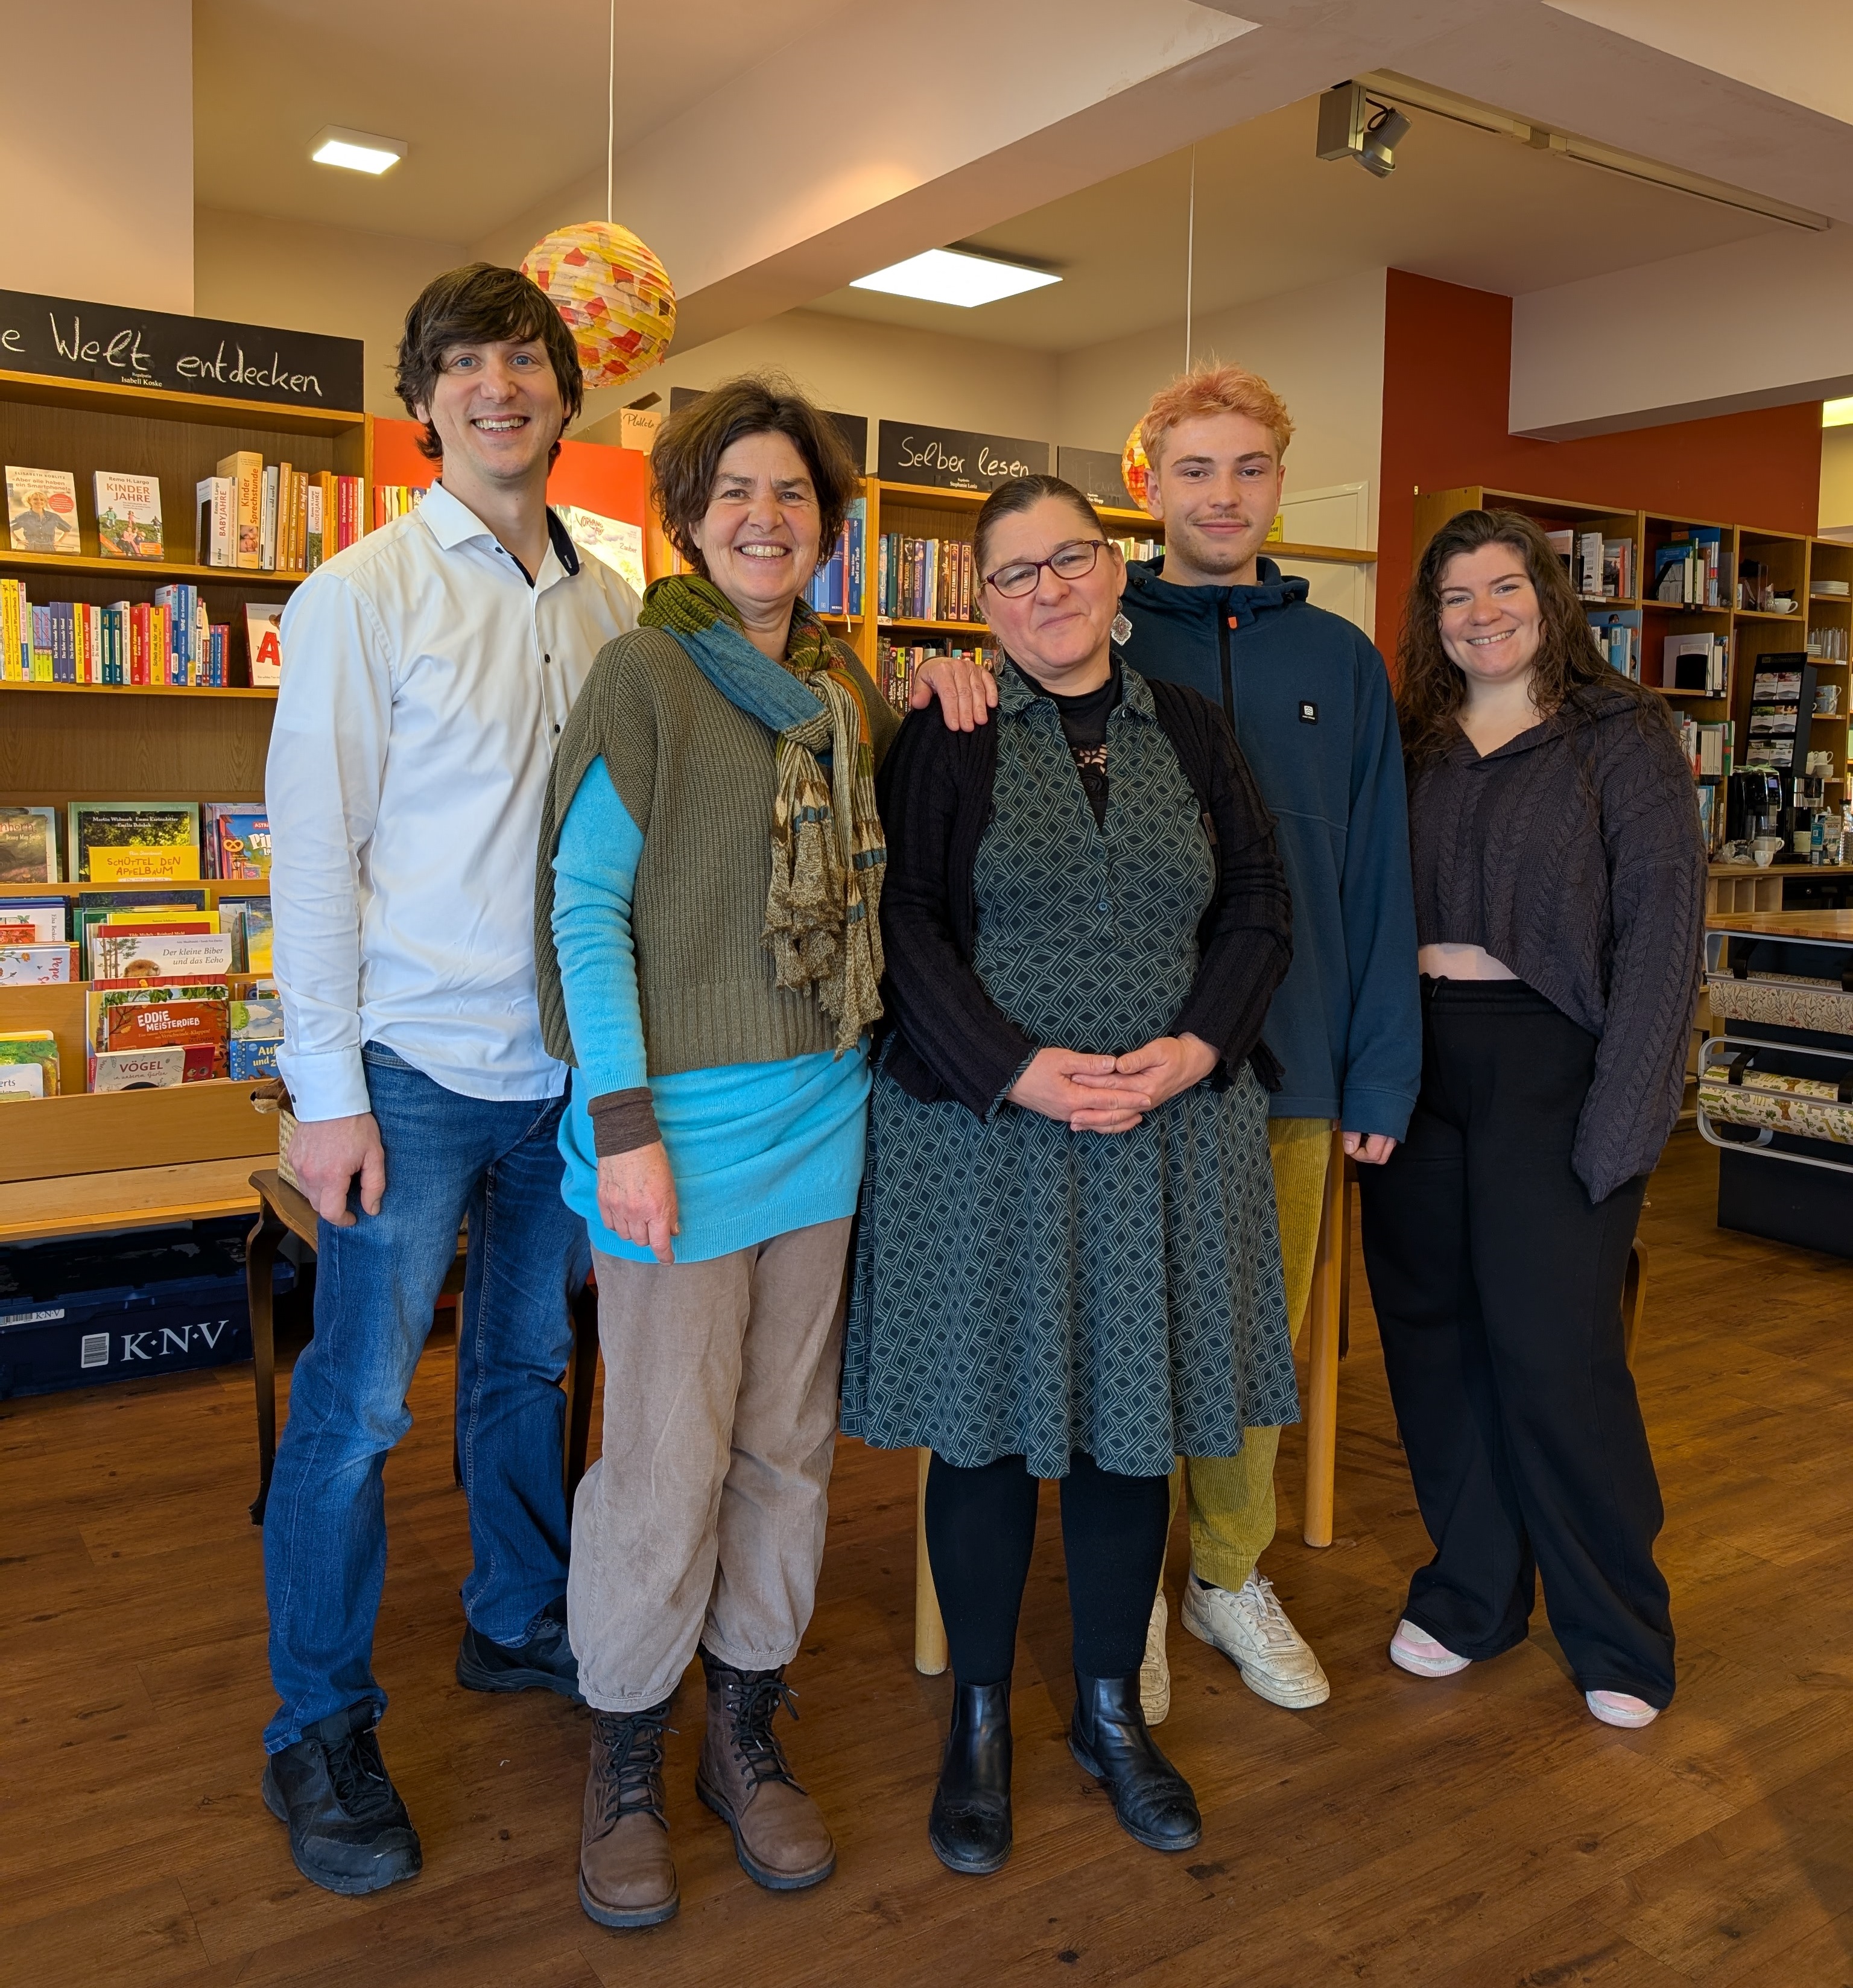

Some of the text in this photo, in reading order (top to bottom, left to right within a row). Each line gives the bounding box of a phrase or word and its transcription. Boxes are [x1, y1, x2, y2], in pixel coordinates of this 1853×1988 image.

[49, 312, 151, 371] Welt
[176, 340, 323, 396] entdecken
[121, 376, 162, 387] Isabell Koske
[898, 436, 1029, 477] Selber lesen
[106, 483, 150, 495] KINDER
[241, 478, 250, 507] Kinder
[113, 492, 151, 503] JAHRE
[250, 469, 259, 524] Sprechstunde
[219, 490, 227, 536] BABYJAHRE
[619, 542, 637, 553] Zauber
[256, 631, 280, 666] A
[107, 856, 180, 866] SCHÜTTEL DEN
[116, 866, 173, 875] APFELBAUM
[258, 1043, 279, 1056] Auf
[119, 1060, 163, 1073] VÖGEL
[253, 1056, 270, 1066] und
